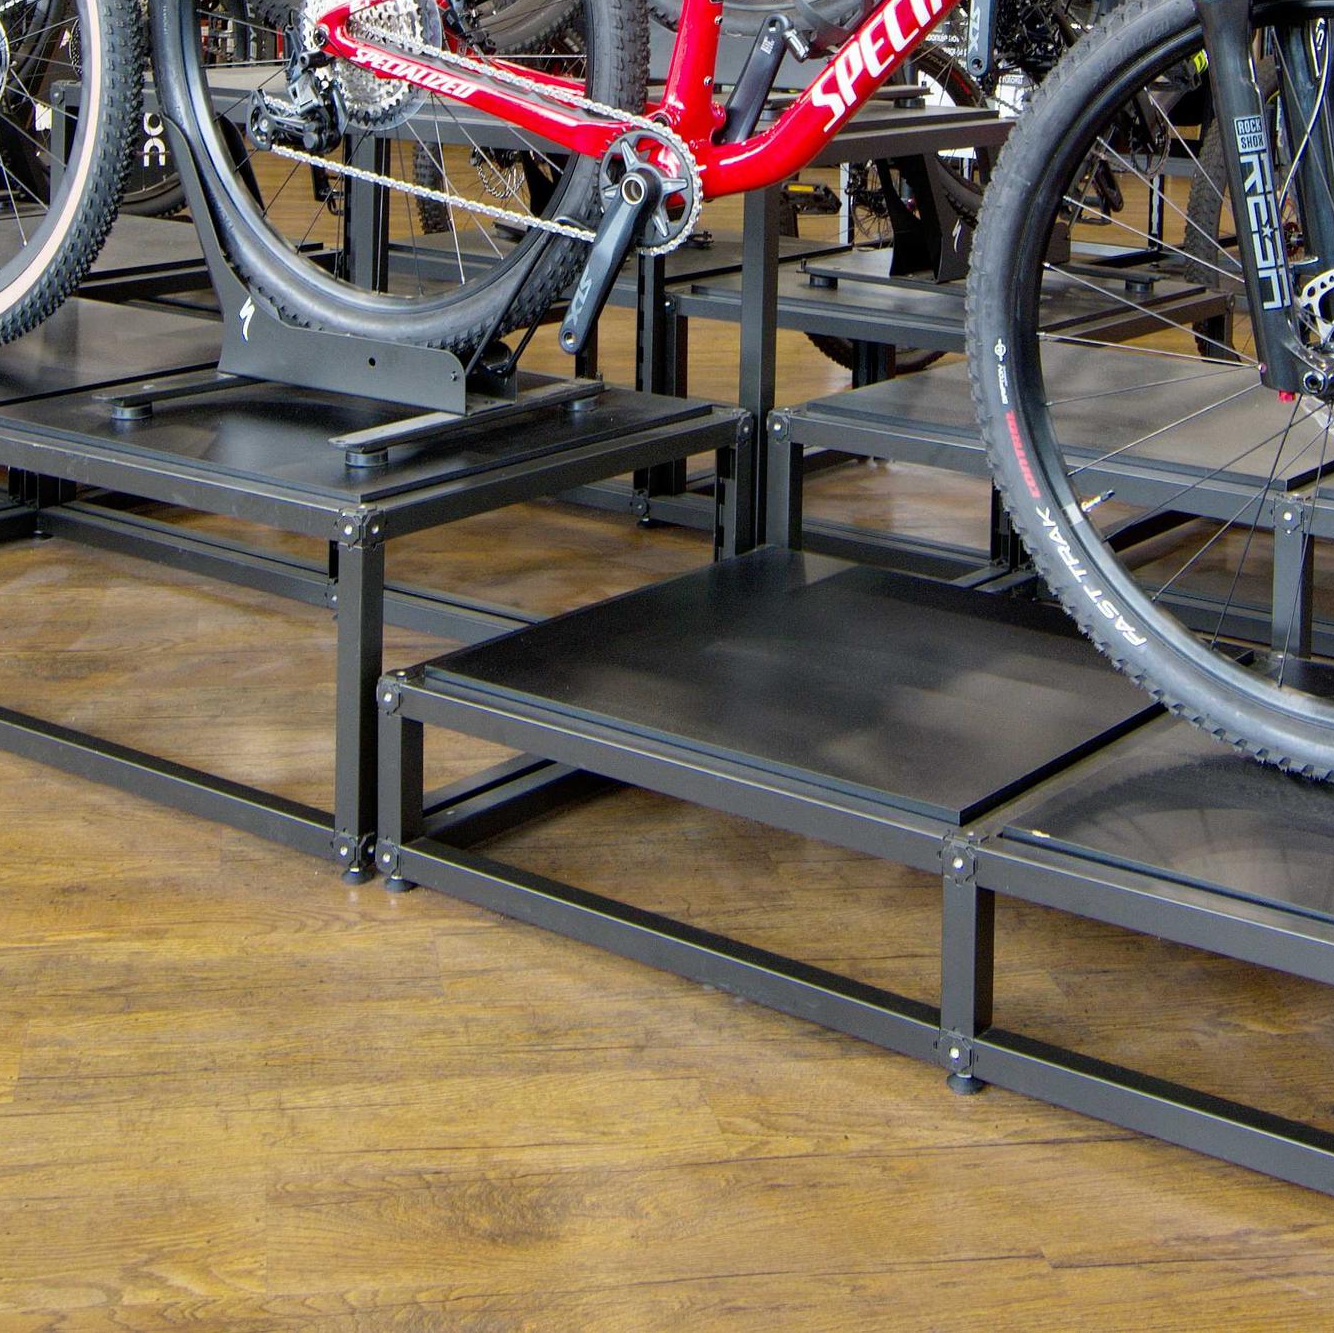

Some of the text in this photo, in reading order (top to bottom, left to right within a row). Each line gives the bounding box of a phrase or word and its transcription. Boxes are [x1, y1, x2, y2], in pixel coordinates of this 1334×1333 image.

[348, 48, 479, 99] SPECIALIZED
[1237, 119, 1262, 136] ROCK
[1240, 134, 1265, 150] SHOX
[1035, 505, 1087, 584] TRAK
[1083, 583, 1147, 647] FAST
